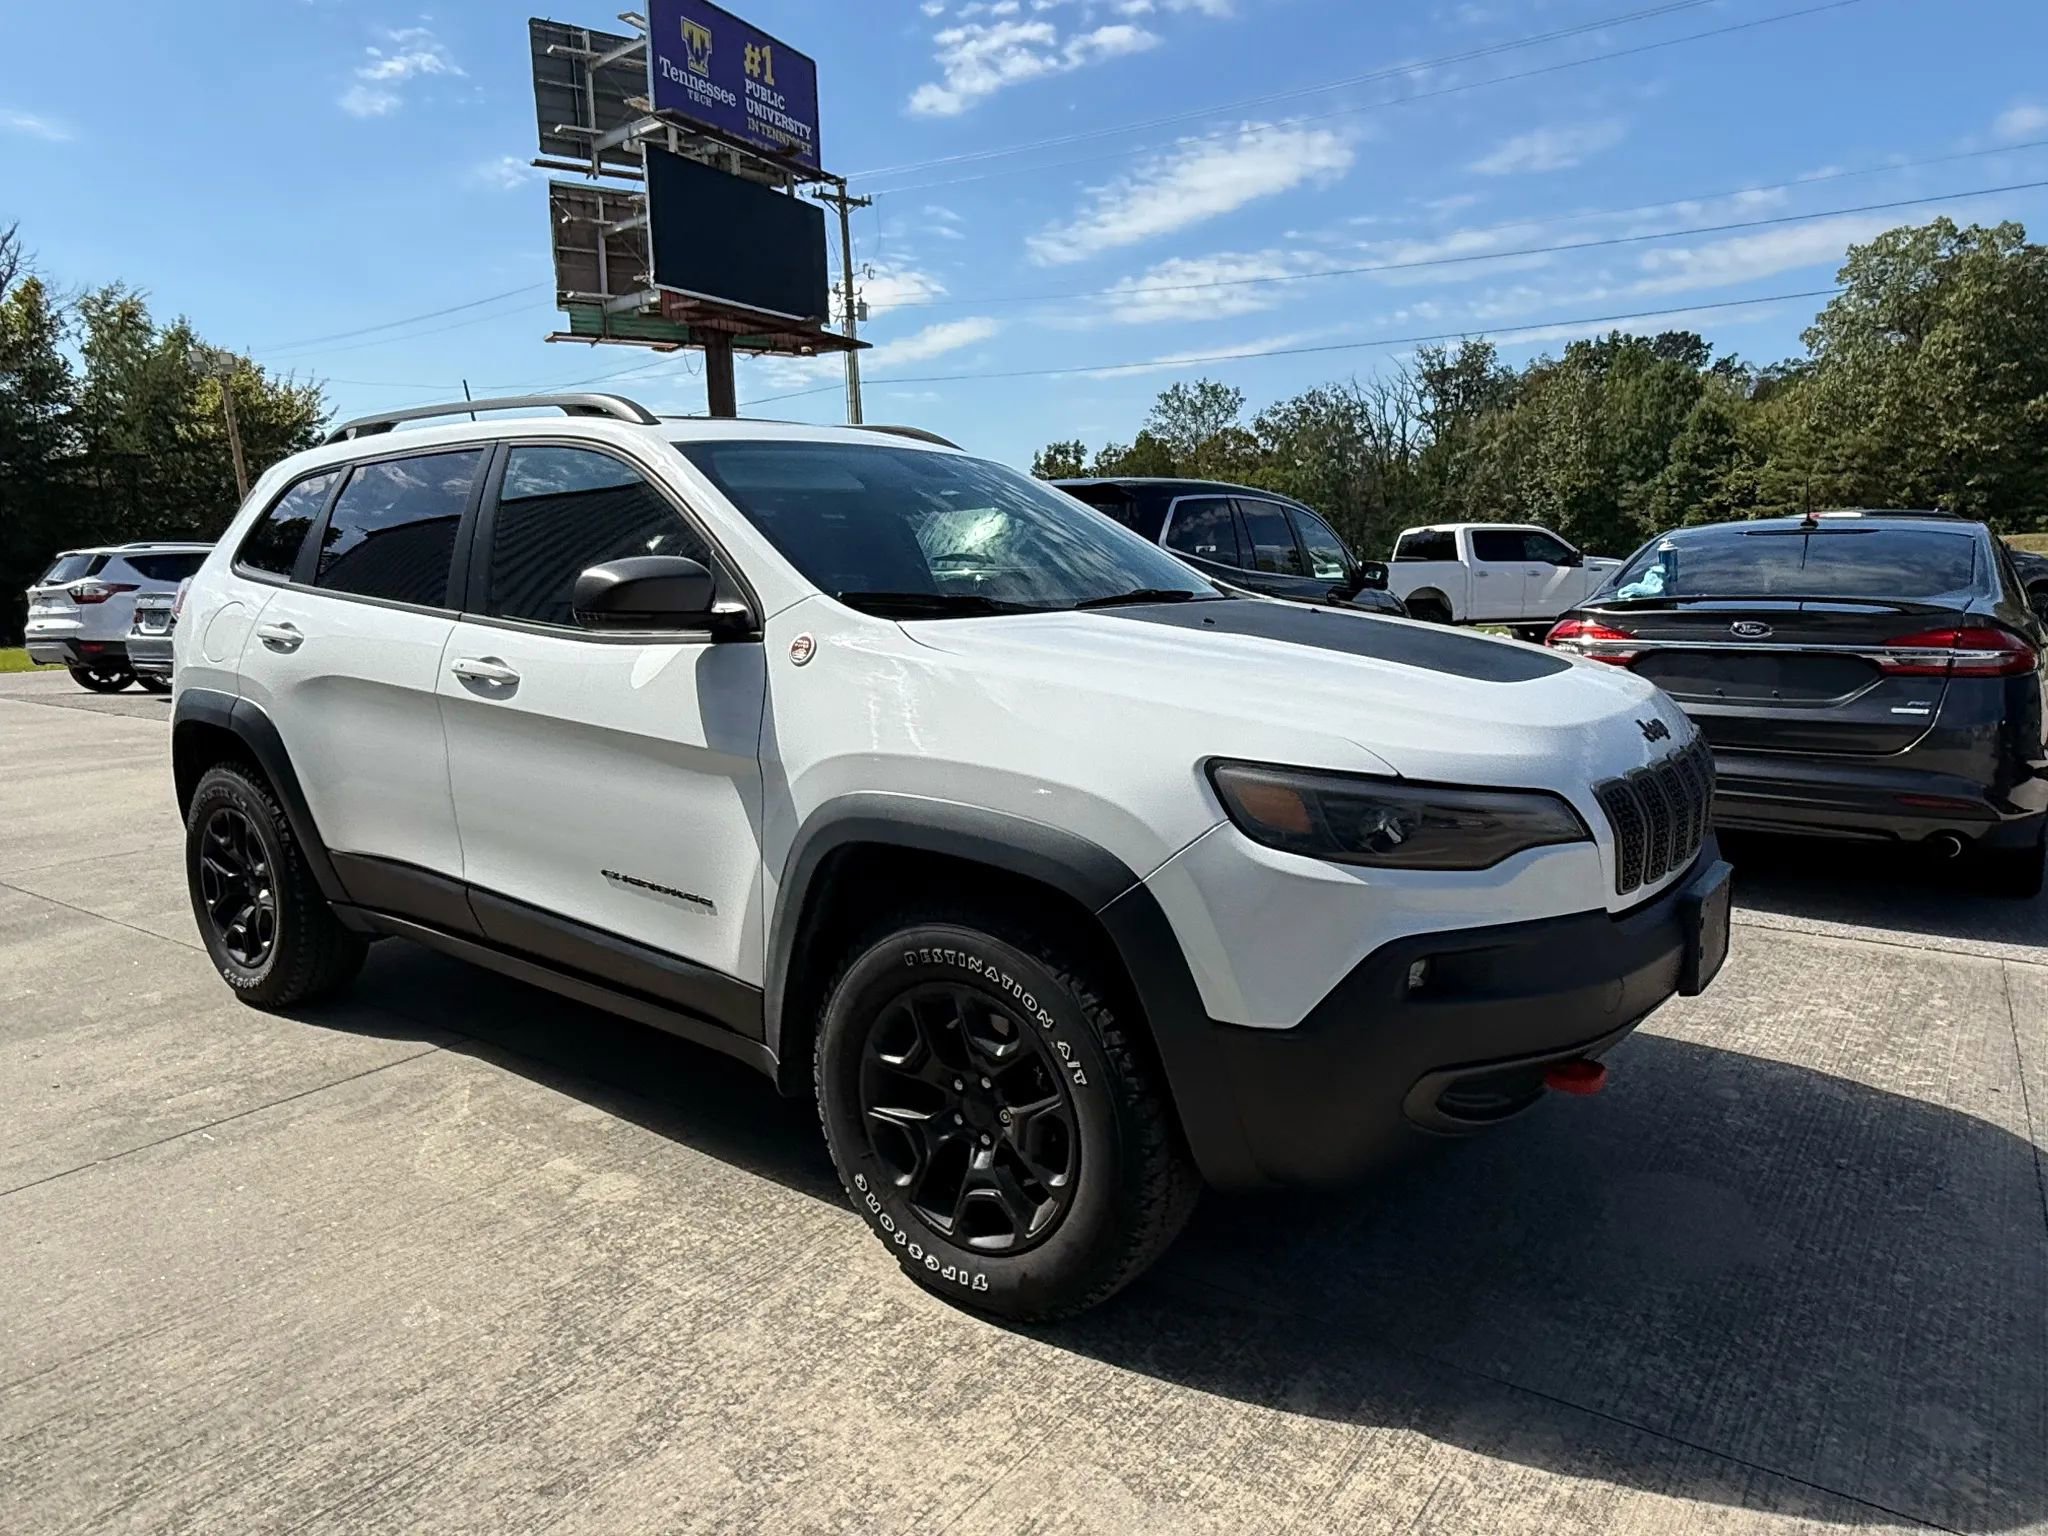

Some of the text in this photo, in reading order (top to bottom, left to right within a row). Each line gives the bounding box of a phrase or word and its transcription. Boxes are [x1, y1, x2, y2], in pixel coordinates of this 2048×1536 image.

[659, 55, 736, 107] Tennessee
[744, 42, 774, 86] #1
[687, 89, 712, 108] TECH
[745, 78, 785, 110] PUBLIC
[745, 97, 811, 140] UNIVERSITY
[904, 949, 1054, 1029] DESTINATION
